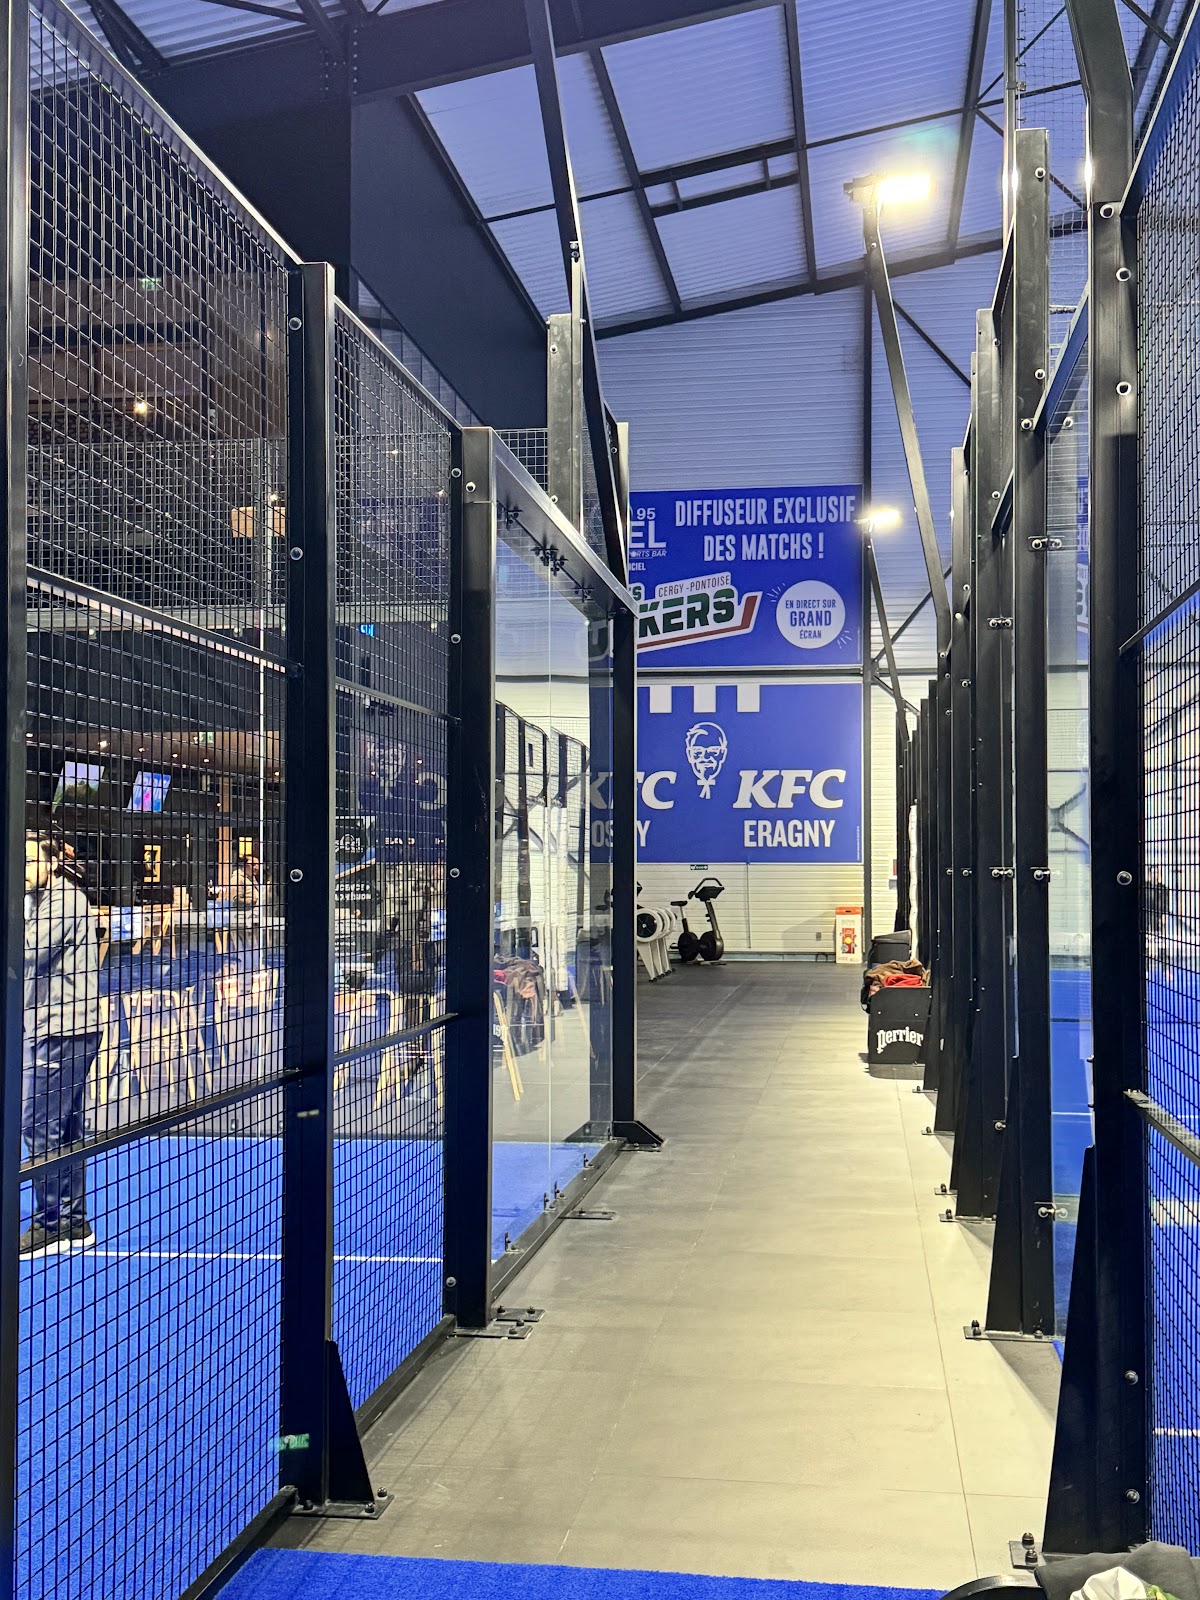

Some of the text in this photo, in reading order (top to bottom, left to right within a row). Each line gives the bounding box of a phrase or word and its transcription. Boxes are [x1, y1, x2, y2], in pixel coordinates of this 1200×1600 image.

[636, 508, 656, 520] 95
[675, 496, 856, 527] DIFFUSEUR EXCLUSIF
[629, 520, 667, 548] EL
[651, 550, 667, 558] BAR
[704, 531, 825, 562] DES MATCHS !
[629, 562, 647, 571] ICIEL
[785, 598, 837, 609] EN DIRECT SUR
[790, 610, 832, 627] GRAND
[799, 628, 822, 640] ÉCRAN
[732, 768, 847, 809] KFC
[743, 819, 836, 848] ERAGNY
[876, 1026, 924, 1054] perrier
